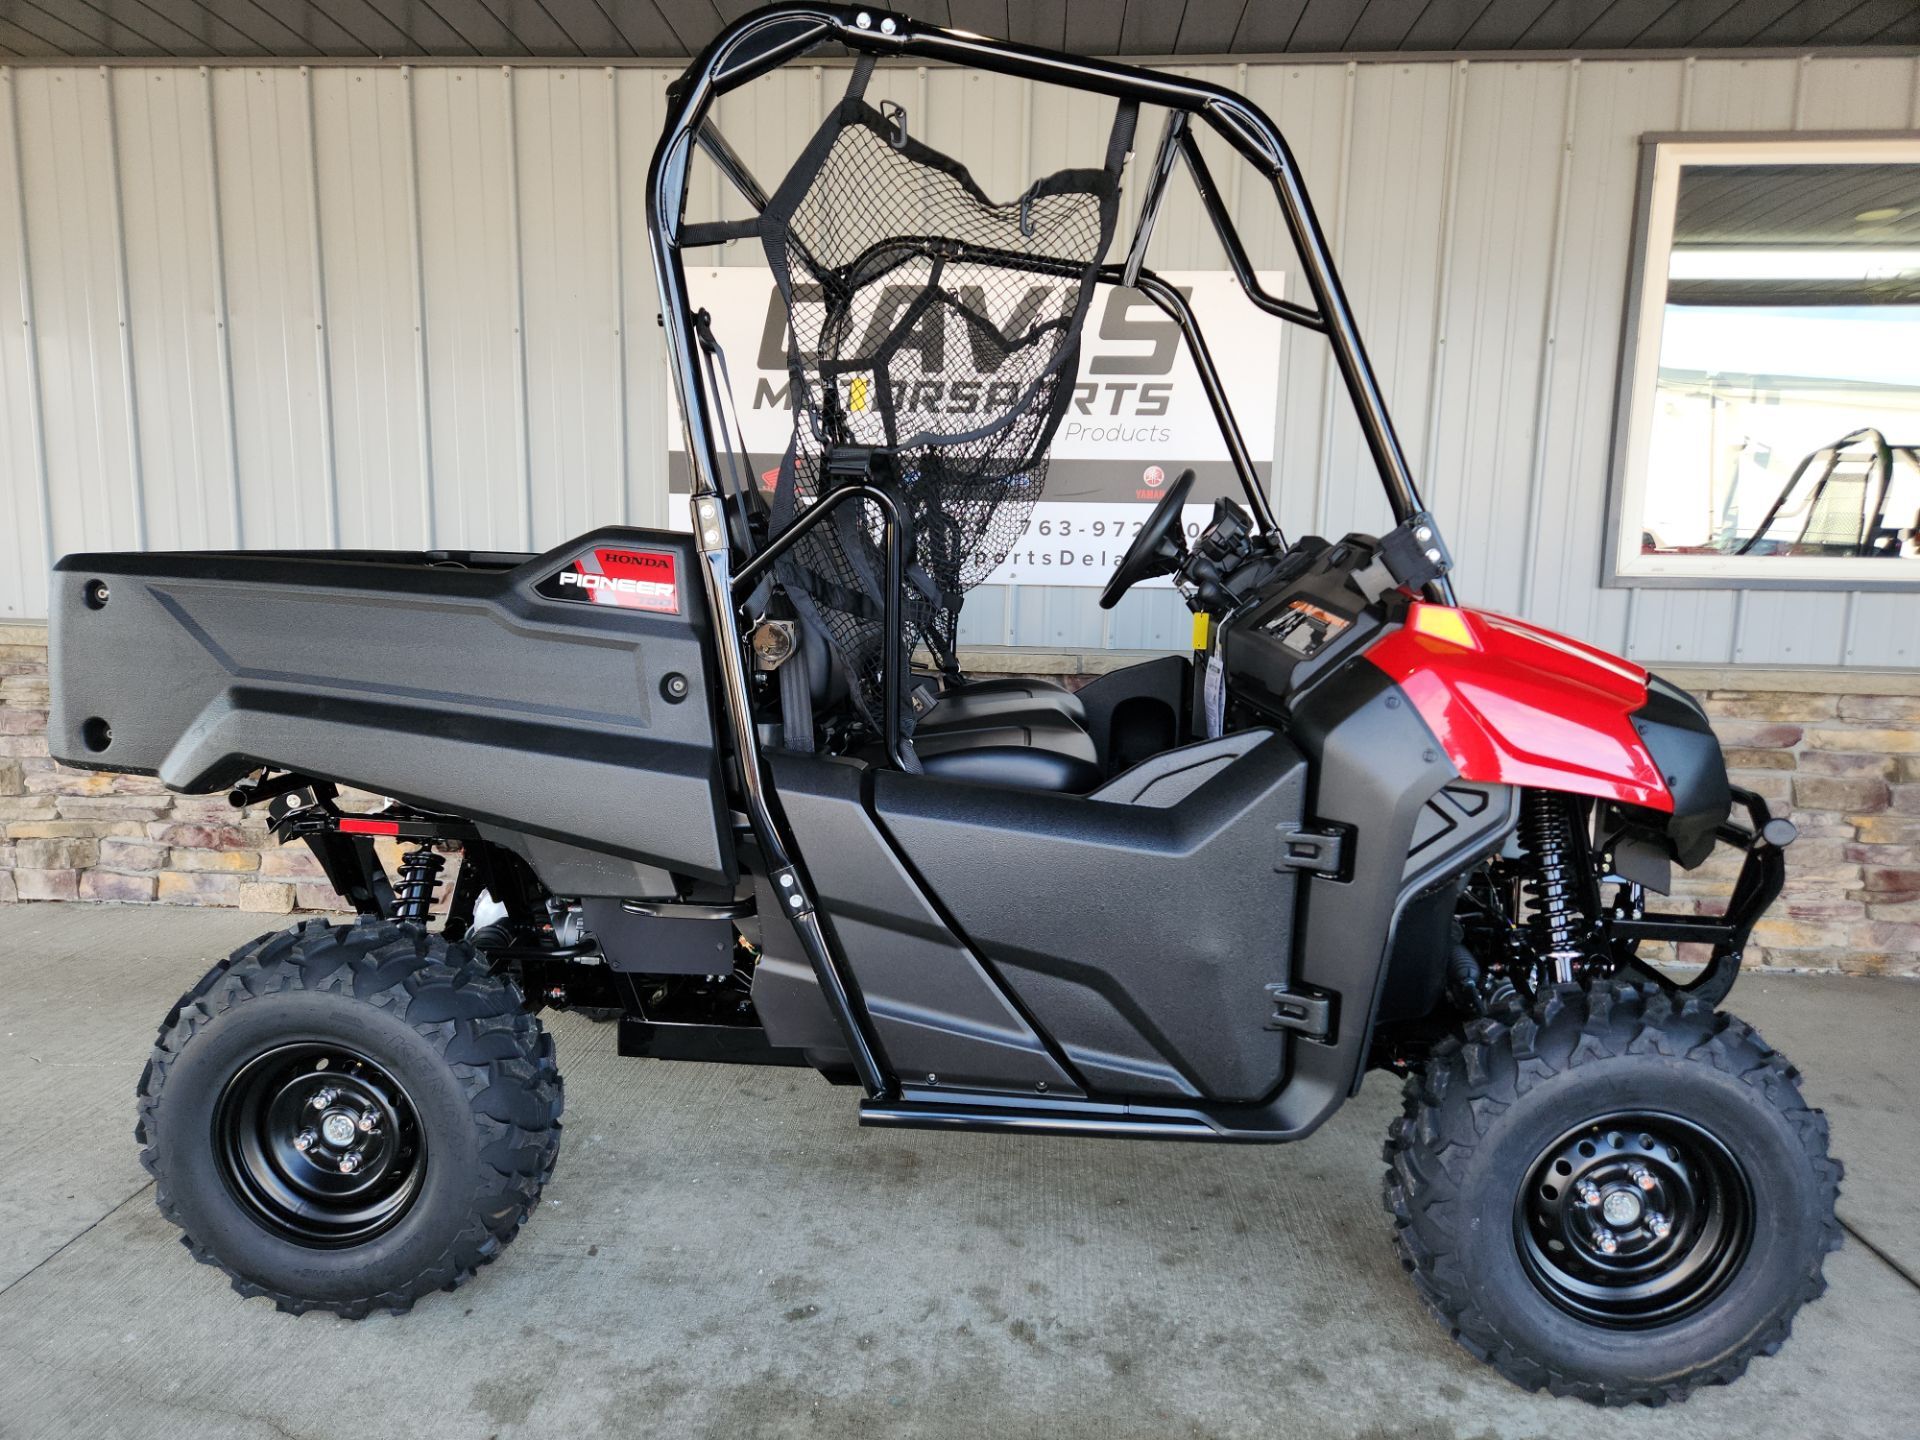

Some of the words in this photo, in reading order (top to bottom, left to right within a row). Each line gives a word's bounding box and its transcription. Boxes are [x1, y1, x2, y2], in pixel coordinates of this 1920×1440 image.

[757, 283, 1193, 375] DAVS
[1065, 422, 1171, 442] Products
[1135, 488, 1166, 501] YAMAH
[604, 553, 670, 569] HONDA
[559, 571, 675, 597] PIONEER
